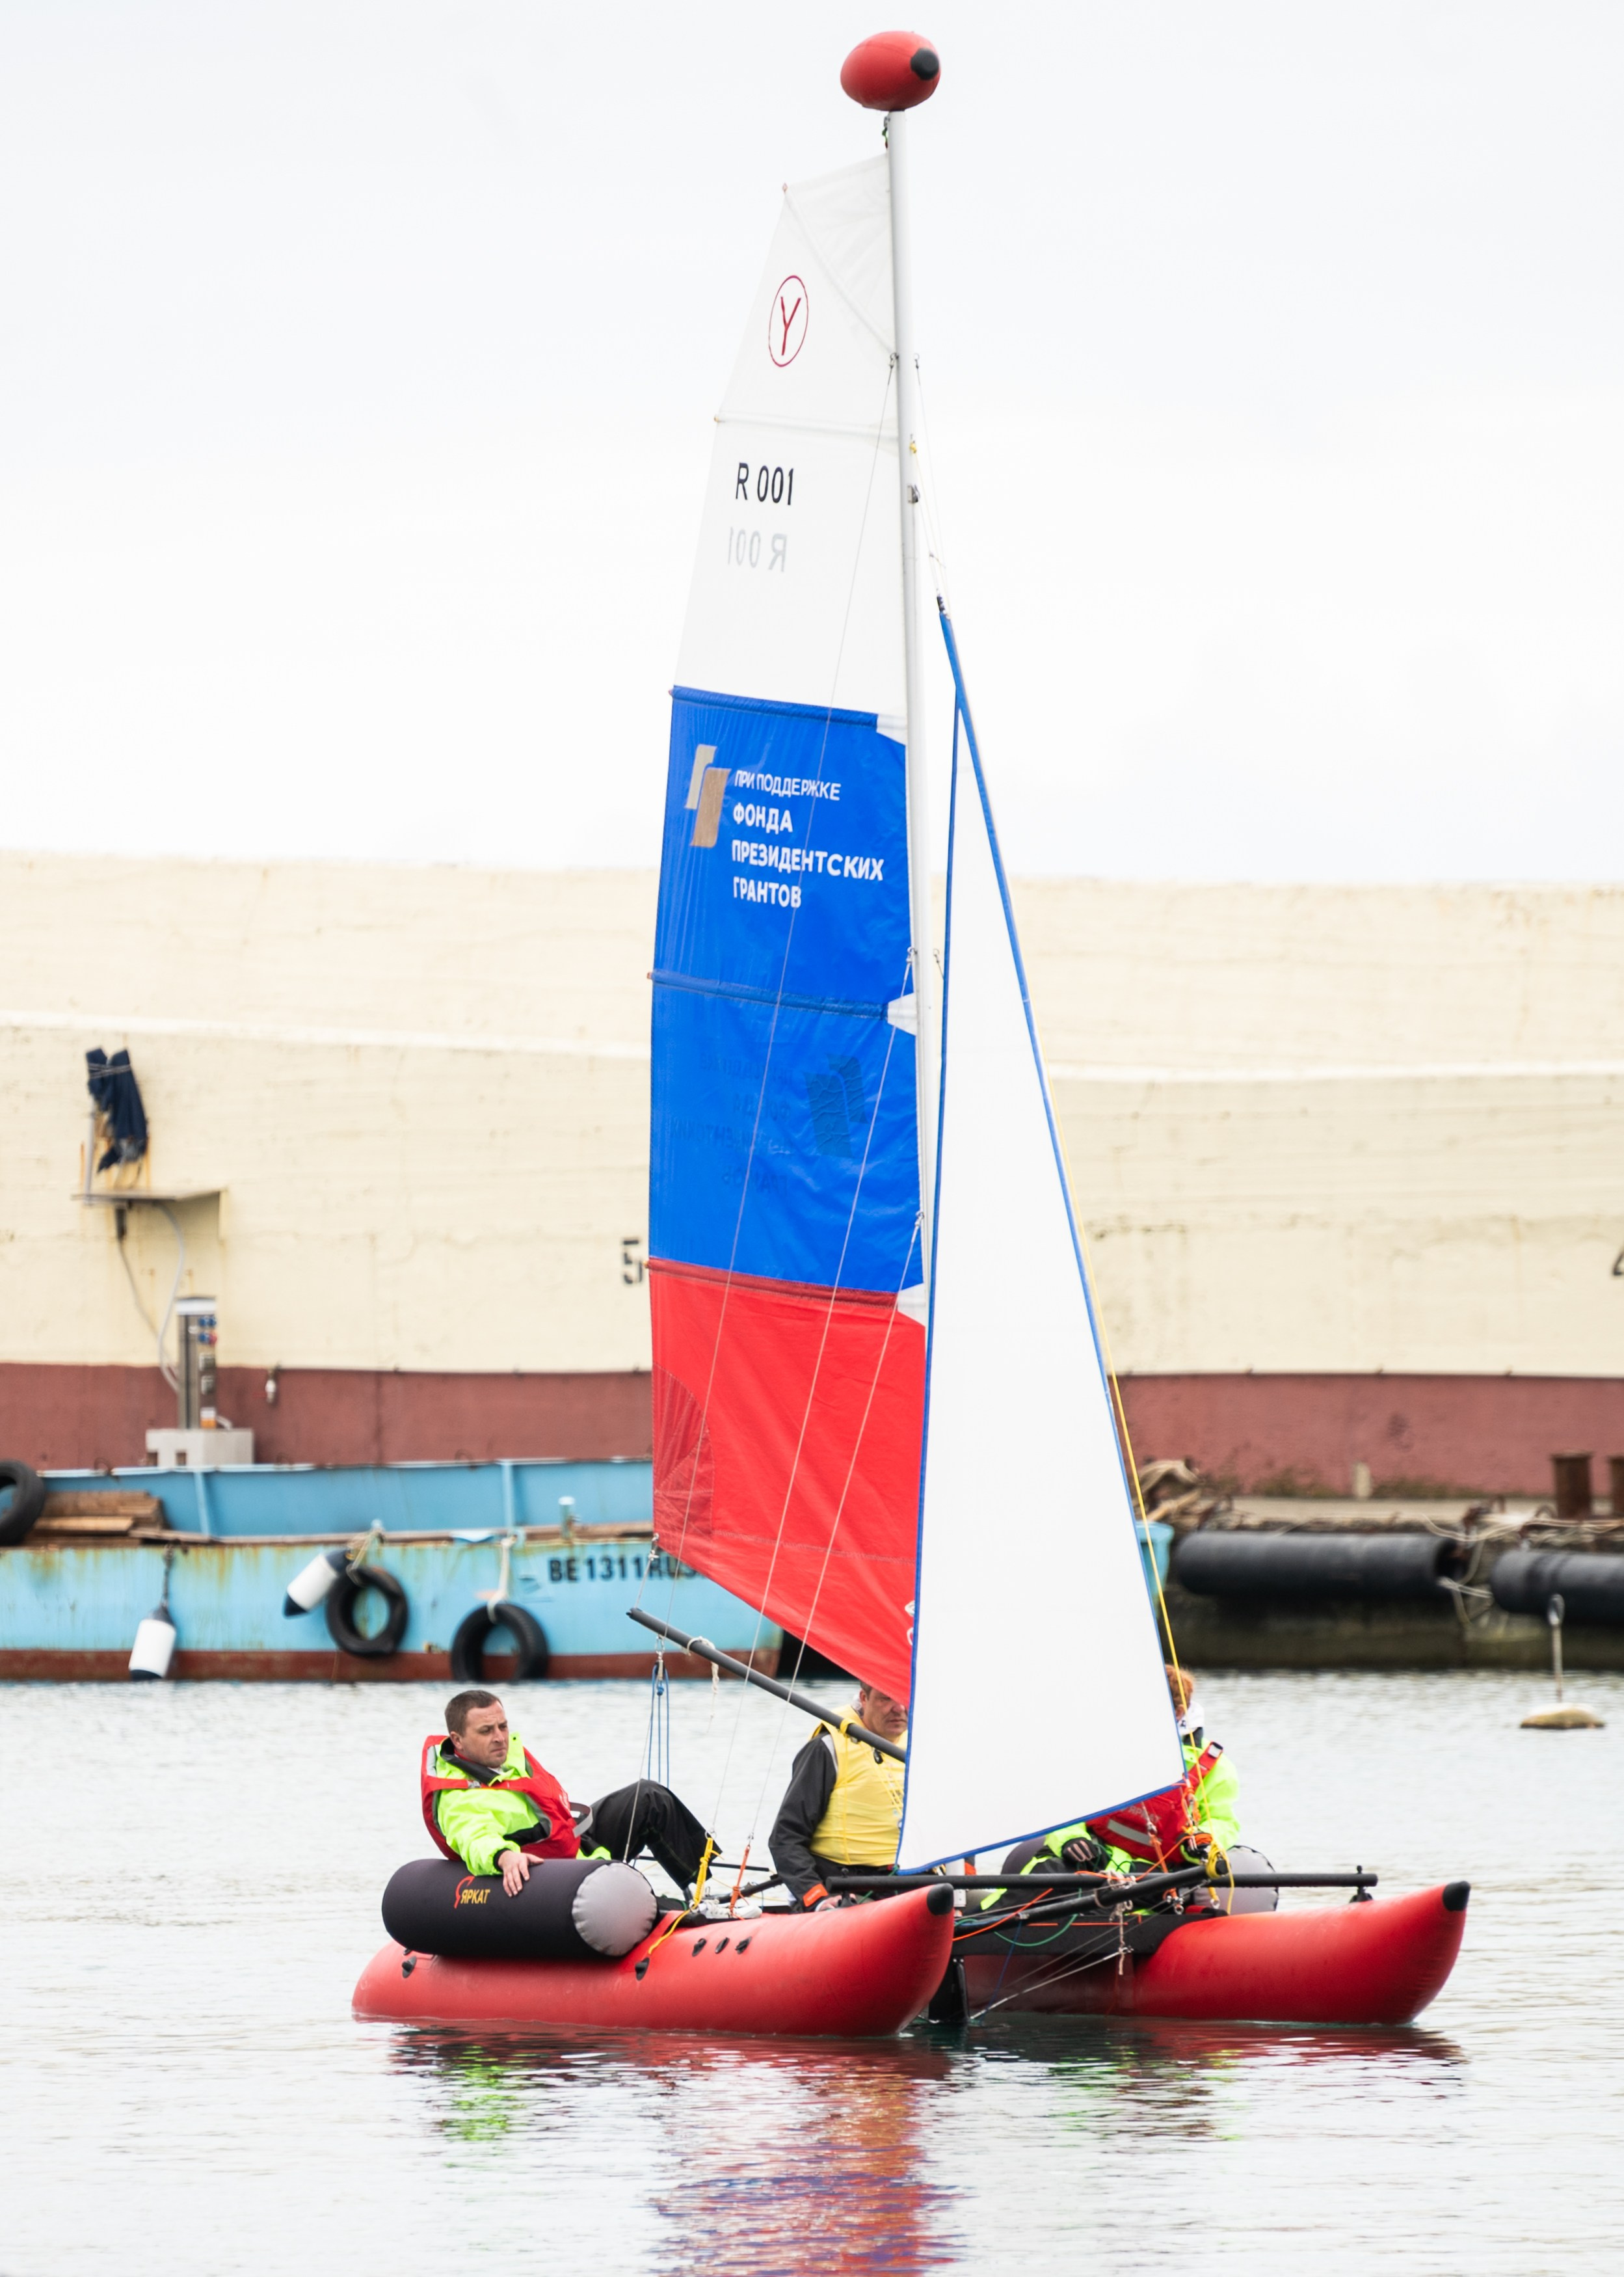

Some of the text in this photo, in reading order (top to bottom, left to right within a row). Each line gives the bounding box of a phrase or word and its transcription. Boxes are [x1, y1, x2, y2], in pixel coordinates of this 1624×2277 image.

[736, 463, 793, 505] R 001
[734, 770, 842, 801] ПРИ ПОДДЕРЖКЕ
[733, 802, 793, 835] ФОНДА
[732, 839, 885, 881] ПРЕЗИДЕНТСКИХ
[733, 876, 801, 908] ГРАНТОВ
[623, 1239, 643, 1284] 5
[460, 1889, 490, 1904] ЯРКАТ
